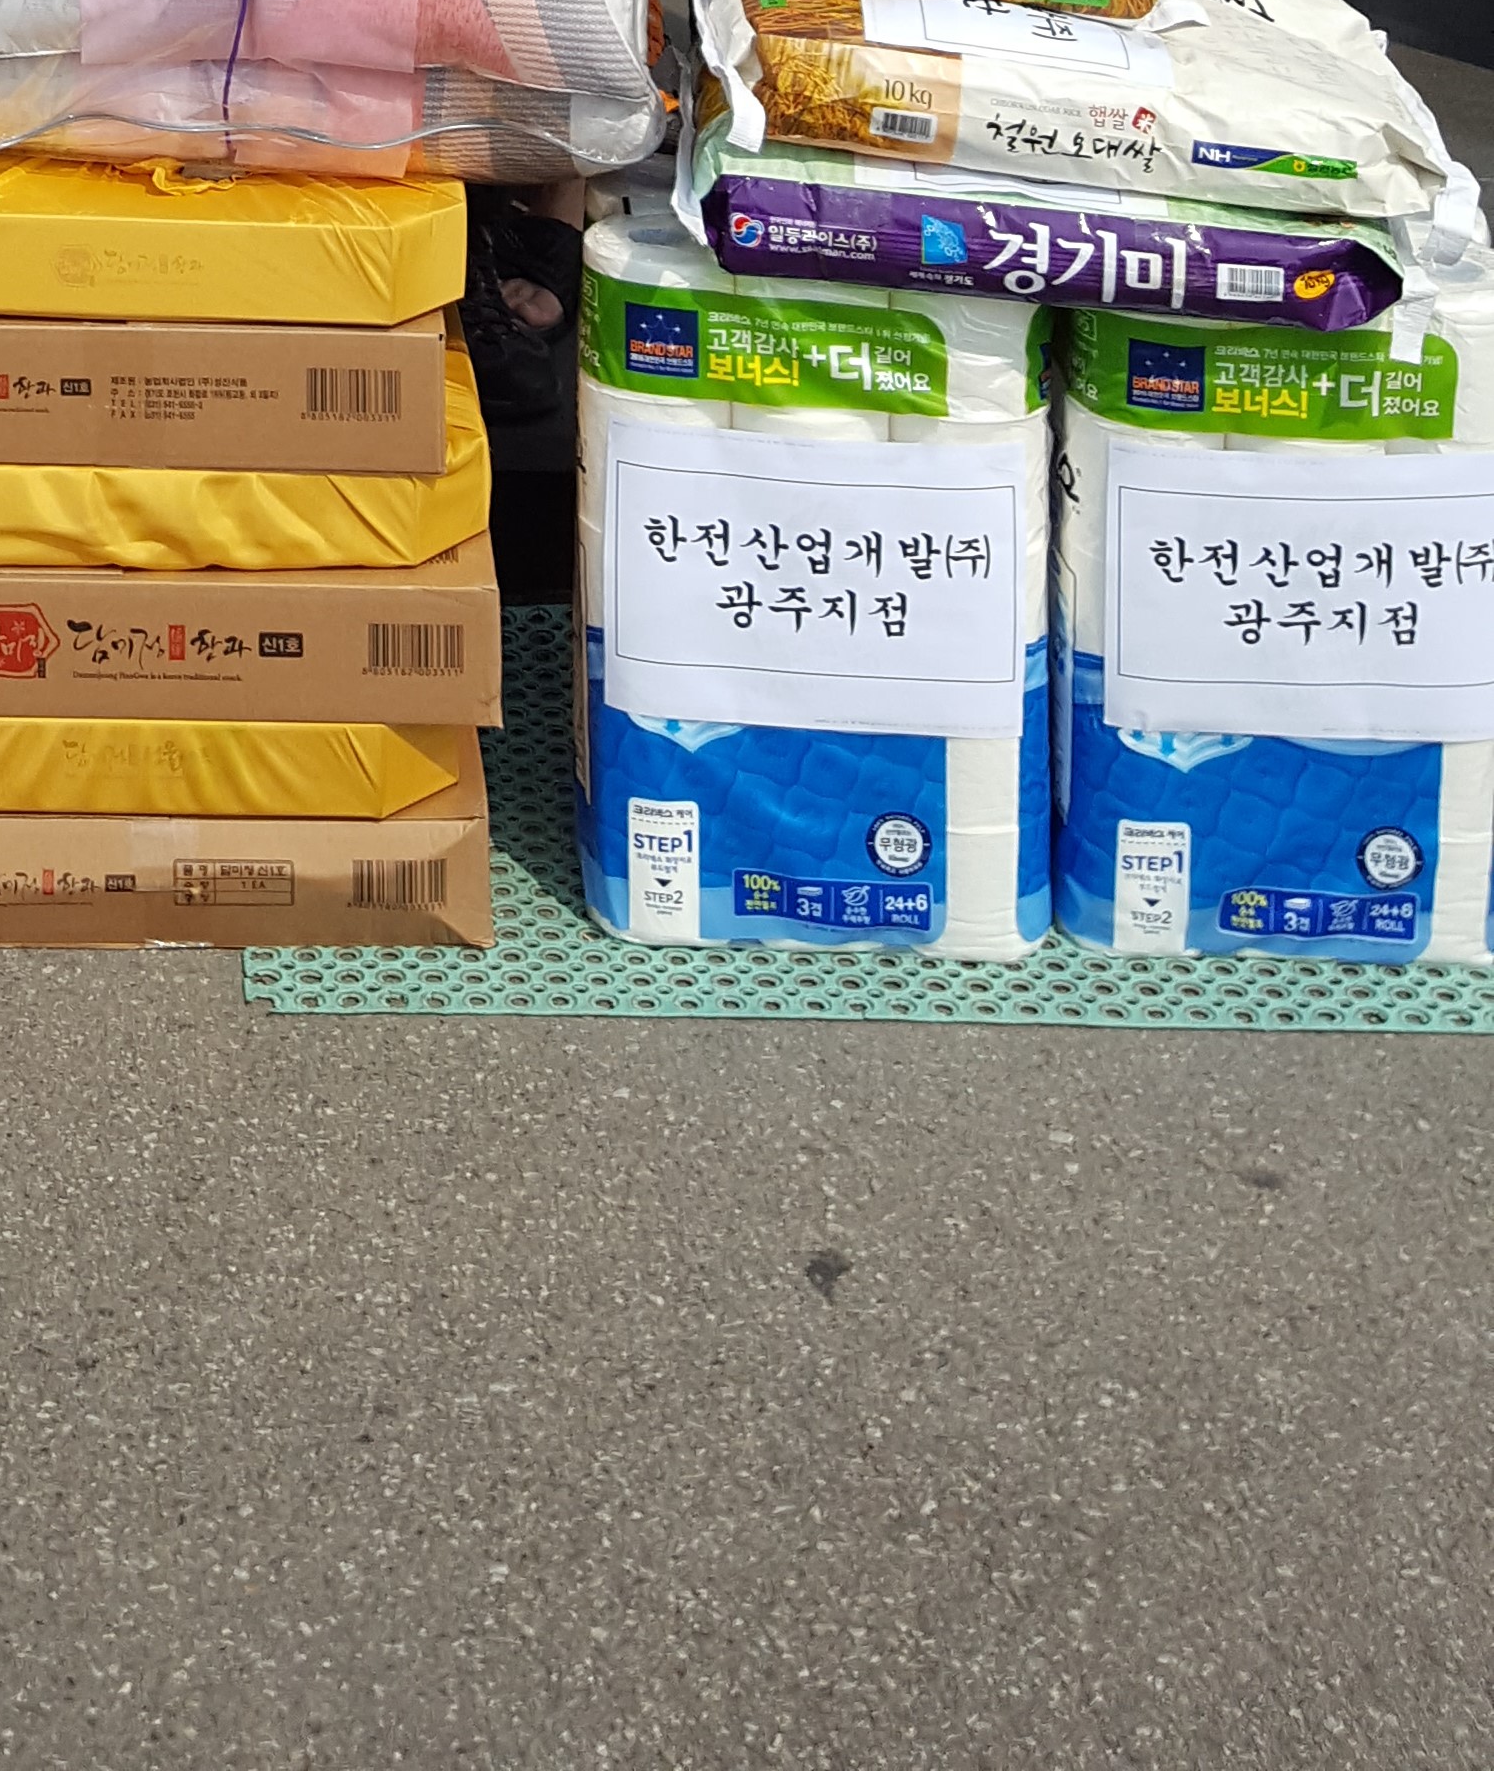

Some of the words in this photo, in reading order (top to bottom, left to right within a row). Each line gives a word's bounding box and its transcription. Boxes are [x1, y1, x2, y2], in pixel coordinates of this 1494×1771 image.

[1087, 104, 1130, 132] 햅쌀
[986, 112, 1058, 155] 철원
[1072, 136, 1163, 175] 오대쌀
[1199, 146, 1232, 165] NH
[982, 219, 1188, 311] 경기미
[944, 273, 975, 286] 경기도
[629, 339, 665, 357] BRAND
[666, 342, 694, 358] STAR
[706, 328, 799, 359] 고객감사
[874, 346, 911, 366] 길어
[706, 353, 800, 388] 보너스!
[1214, 361, 1309, 389] 고객감사
[874, 372, 931, 393] 졌어요
[1132, 376, 1171, 394] BRAND
[1172, 378, 1200, 394] STAR
[1385, 372, 1423, 392] 길어
[1211, 388, 1308, 420] 보너스!
[1382, 396, 1440, 416] 졌어요
[643, 514, 992, 580] 한전산업개발(주)
[714, 581, 909, 637] 광주지점
[1223, 599, 1421, 646] 광주지점
[259, 635, 302, 656] 신1호
[878, 837, 918, 853] 무형광
[742, 874, 781, 892] 100%
[796, 897, 822, 918] 3겹
[884, 893, 928, 912] 24+6
[1231, 892, 1267, 907] 100%
[890, 914, 920, 926] ROLL
[1283, 914, 1311, 932] 3겹
[1374, 918, 1405, 933] ROLL
